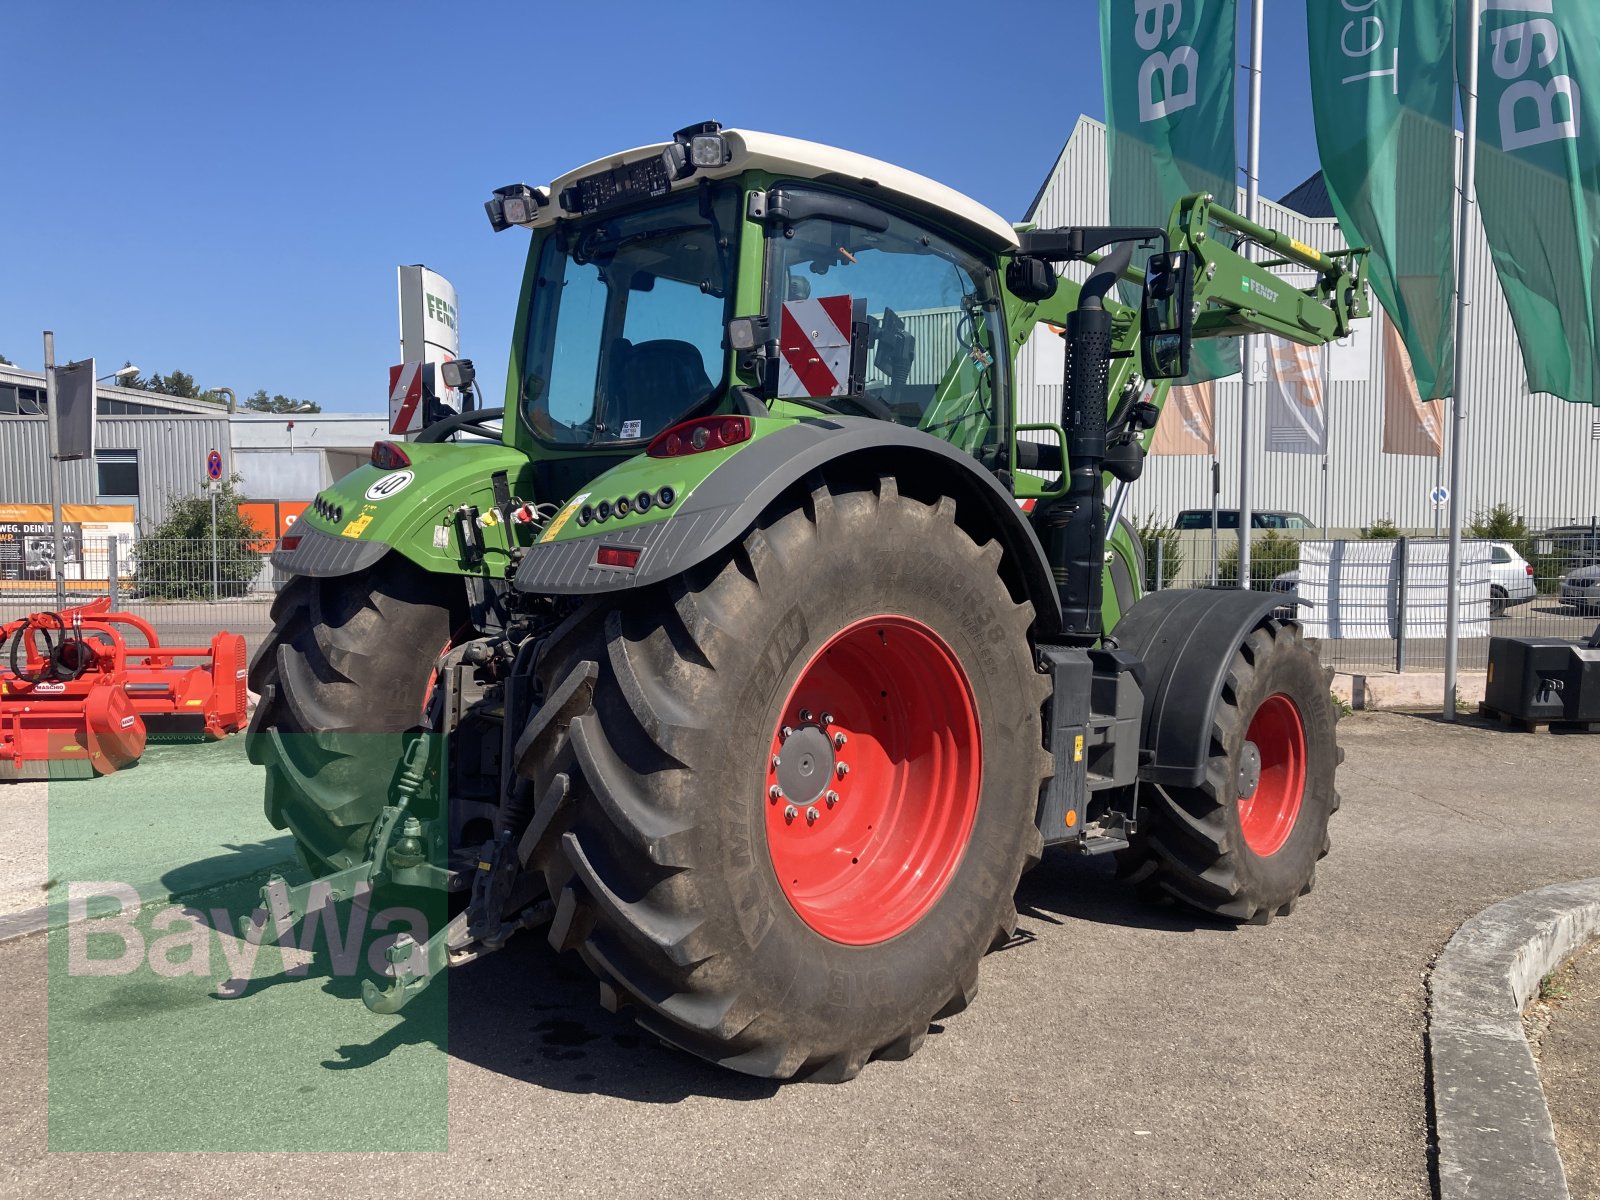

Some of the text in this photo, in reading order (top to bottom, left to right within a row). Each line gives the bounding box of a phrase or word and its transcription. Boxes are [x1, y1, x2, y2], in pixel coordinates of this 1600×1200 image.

[1250, 278, 1279, 303] FENDT
[426, 292, 457, 330] FEND
[373, 474, 407, 495] 40
[23, 524, 44, 533] DEIN
[47, 524, 75, 533] TM.
